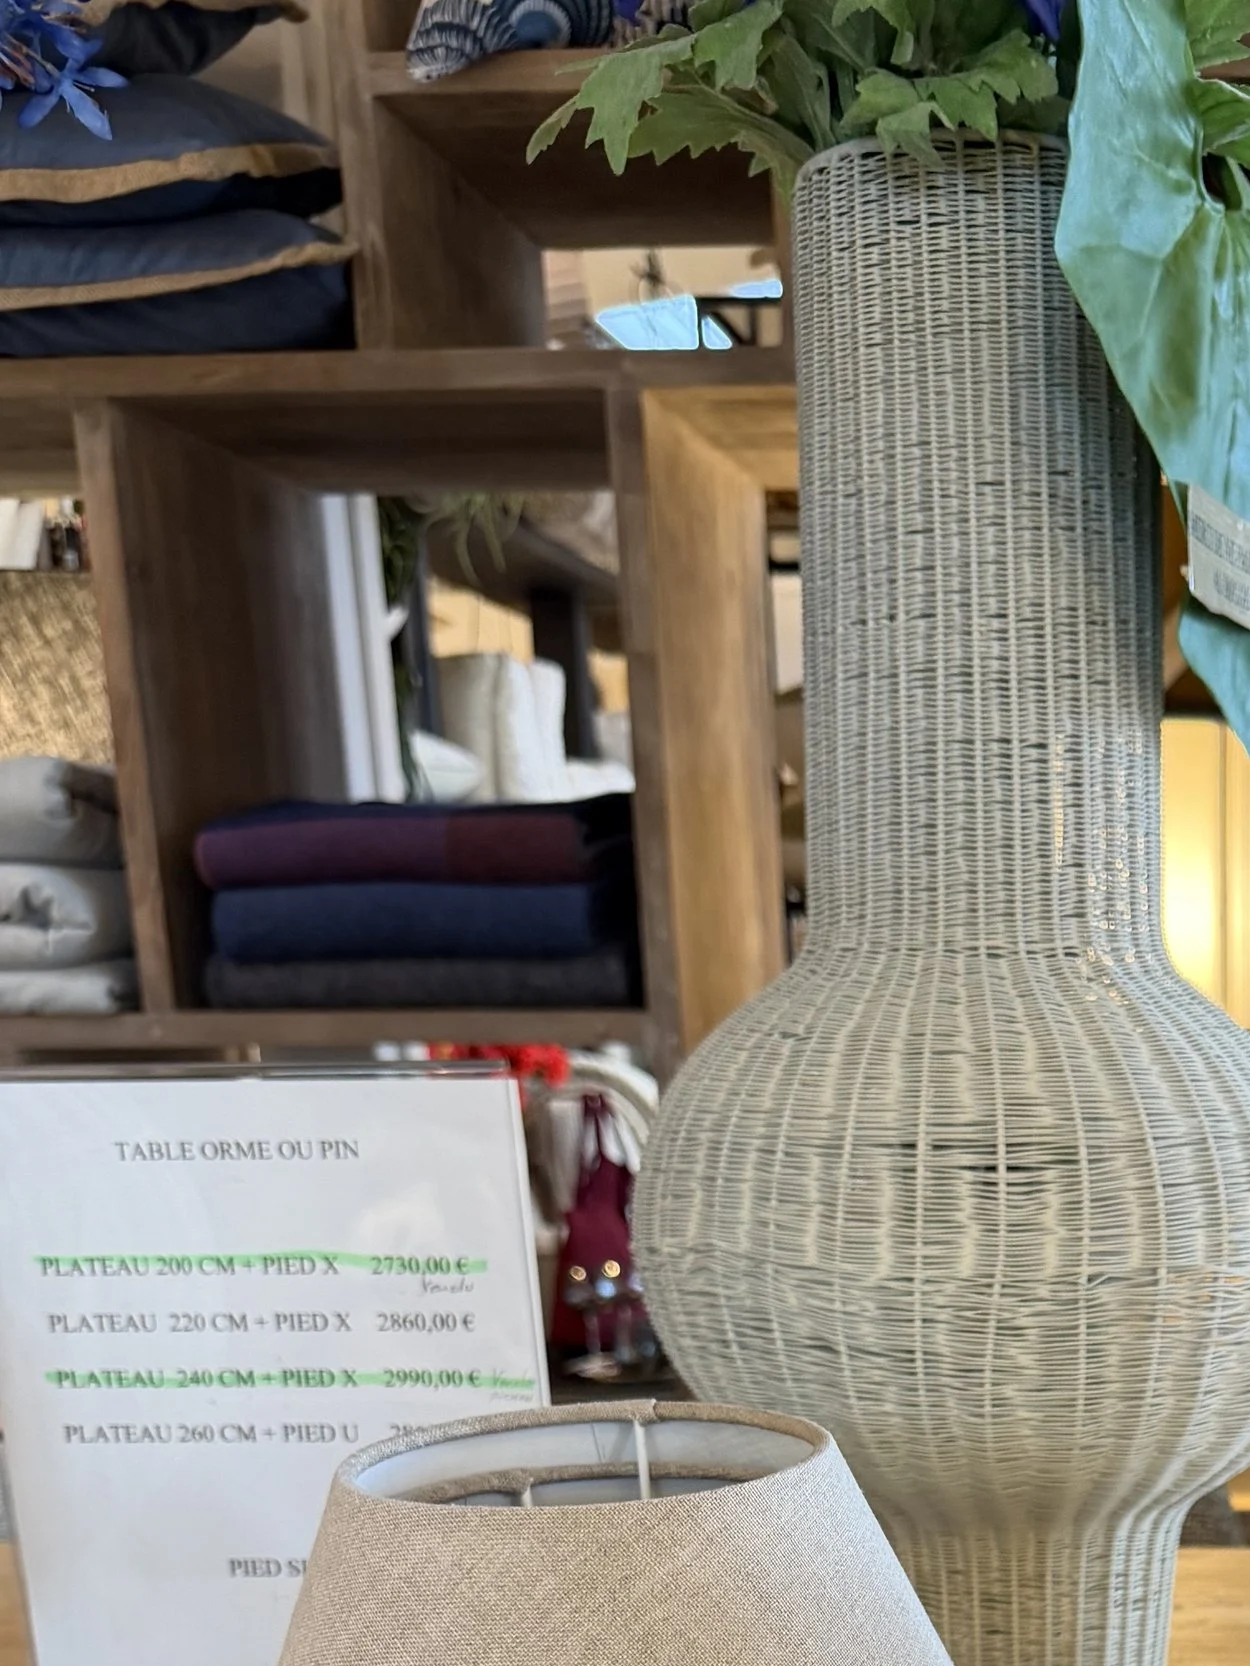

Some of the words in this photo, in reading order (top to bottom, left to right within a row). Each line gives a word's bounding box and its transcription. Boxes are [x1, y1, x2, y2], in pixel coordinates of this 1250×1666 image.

[114, 1141, 196, 1162] TABLE
[200, 1140, 272, 1161] ORME
[278, 1140, 313, 1161] OU
[319, 1140, 359, 1160] PIN
[40, 1256, 149, 1277] PLATEAU
[156, 1256, 193, 1276] 200
[198, 1256, 236, 1276] CM
[241, 1258, 256, 1272] +
[262, 1255, 317, 1275] PIED
[321, 1255, 339, 1275] X
[371, 1256, 451, 1276] 2730,00
[455, 1256, 469, 1275] €
[48, 1313, 157, 1333] PLATEAU
[169, 1313, 207, 1333] 220
[211, 1313, 249, 1333] CM
[254, 1316, 269, 1328] +
[274, 1312, 329, 1332] PIED
[334, 1312, 351, 1332] X
[377, 1313, 457, 1333] 2860,00
[461, 1313, 475, 1332] €
[55, 1369, 165, 1389] PLATEAU
[176, 1369, 214, 1388] 240
[217, 1369, 256, 1388] CM
[261, 1372, 276, 1384] +
[281, 1368, 336, 1388] PIED
[341, 1368, 358, 1388] X
[383, 1368, 464, 1391] 2990,00
[467, 1369, 481, 1388] €
[63, 1424, 172, 1444] PLATEAU
[177, 1424, 215, 1444] 260
[219, 1424, 257, 1443] CM
[262, 1427, 277, 1439] +
[282, 1423, 337, 1443] PIED
[341, 1423, 360, 1443] U
[228, 1558, 283, 1578] PIED
